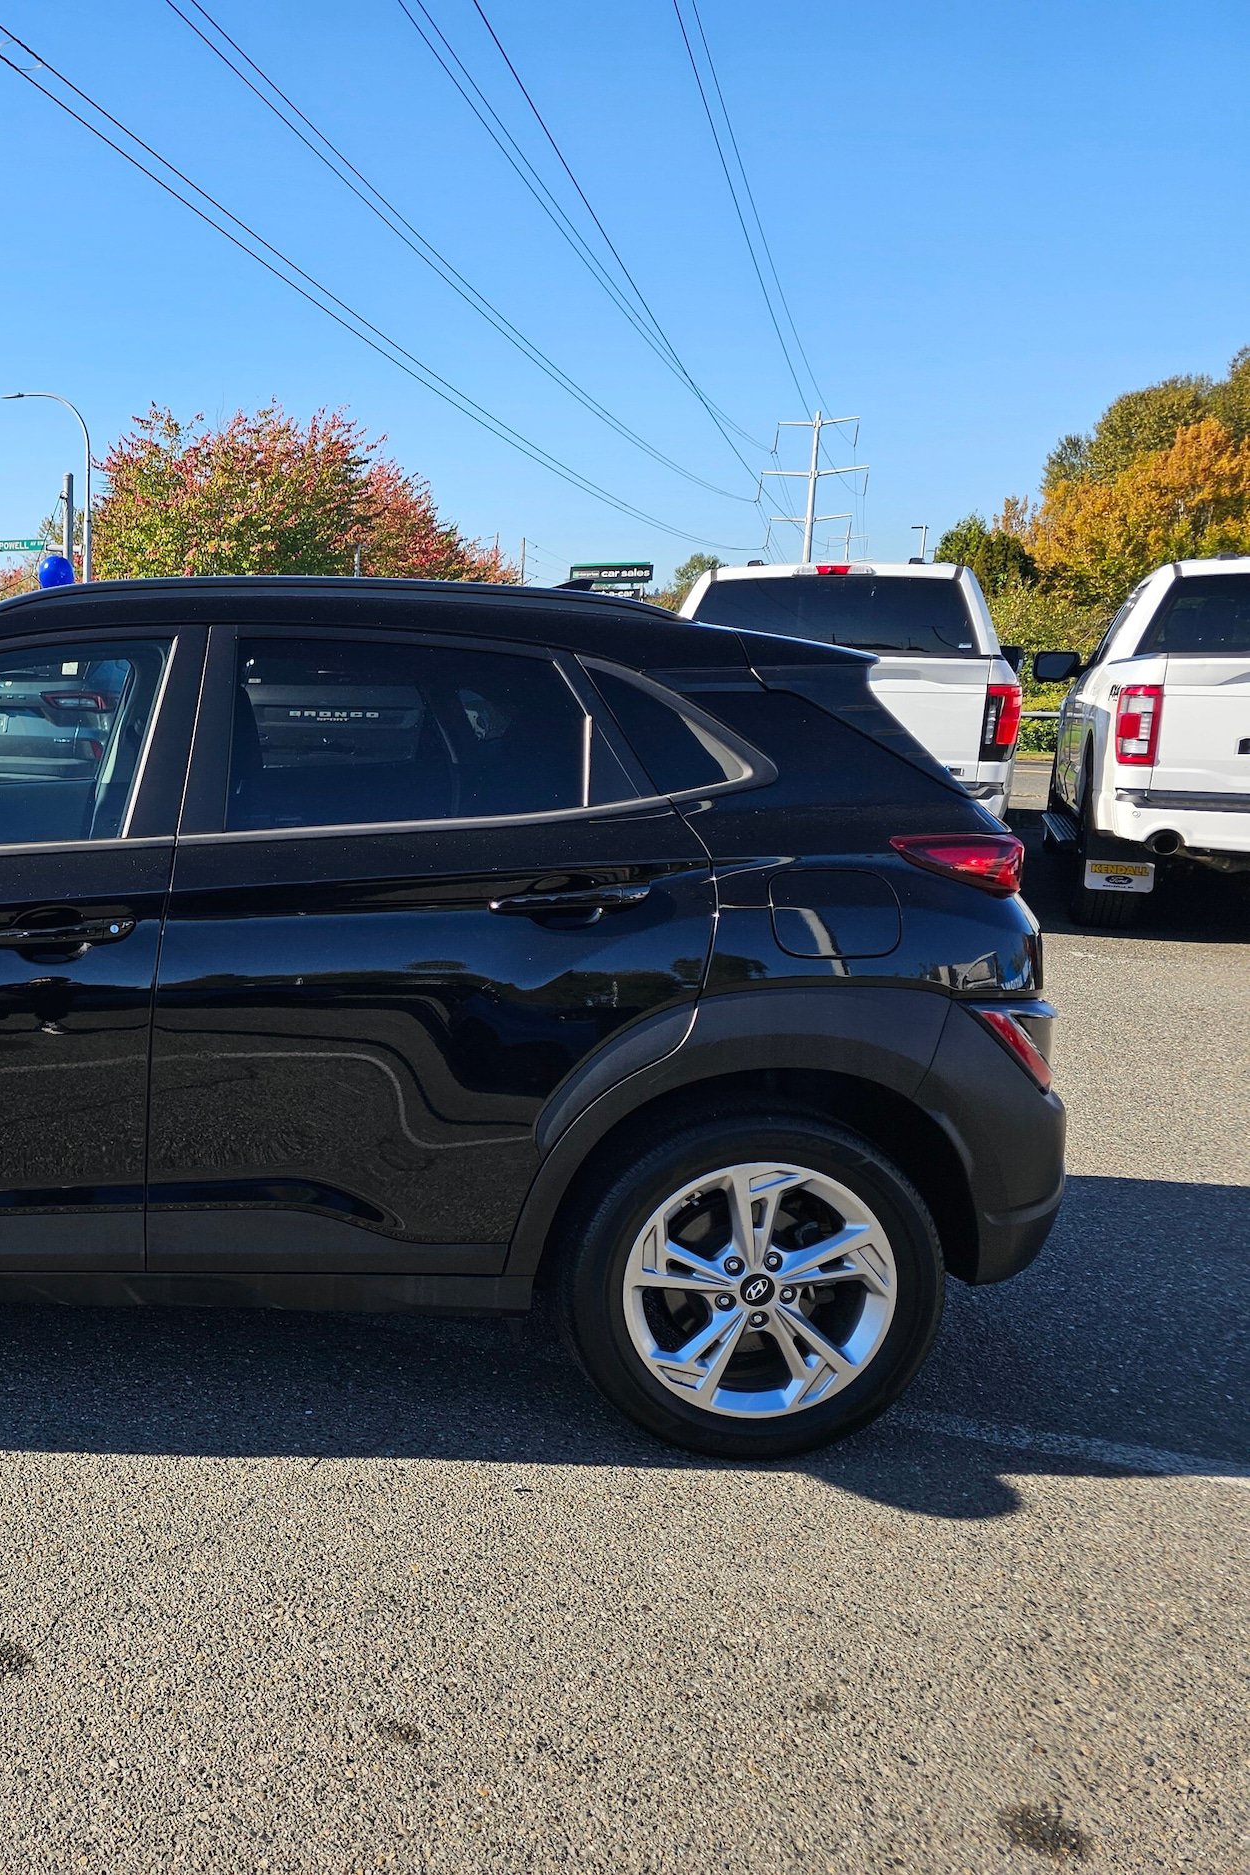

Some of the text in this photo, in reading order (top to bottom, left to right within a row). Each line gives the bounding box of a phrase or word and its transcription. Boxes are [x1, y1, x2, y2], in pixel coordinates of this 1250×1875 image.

[601, 570, 620, 578] car
[621, 567, 650, 577] sales
[289, 710, 380, 718] BRONCO
[1090, 864, 1150, 876] KENDALL
[1107, 876, 1131, 885] Ford
